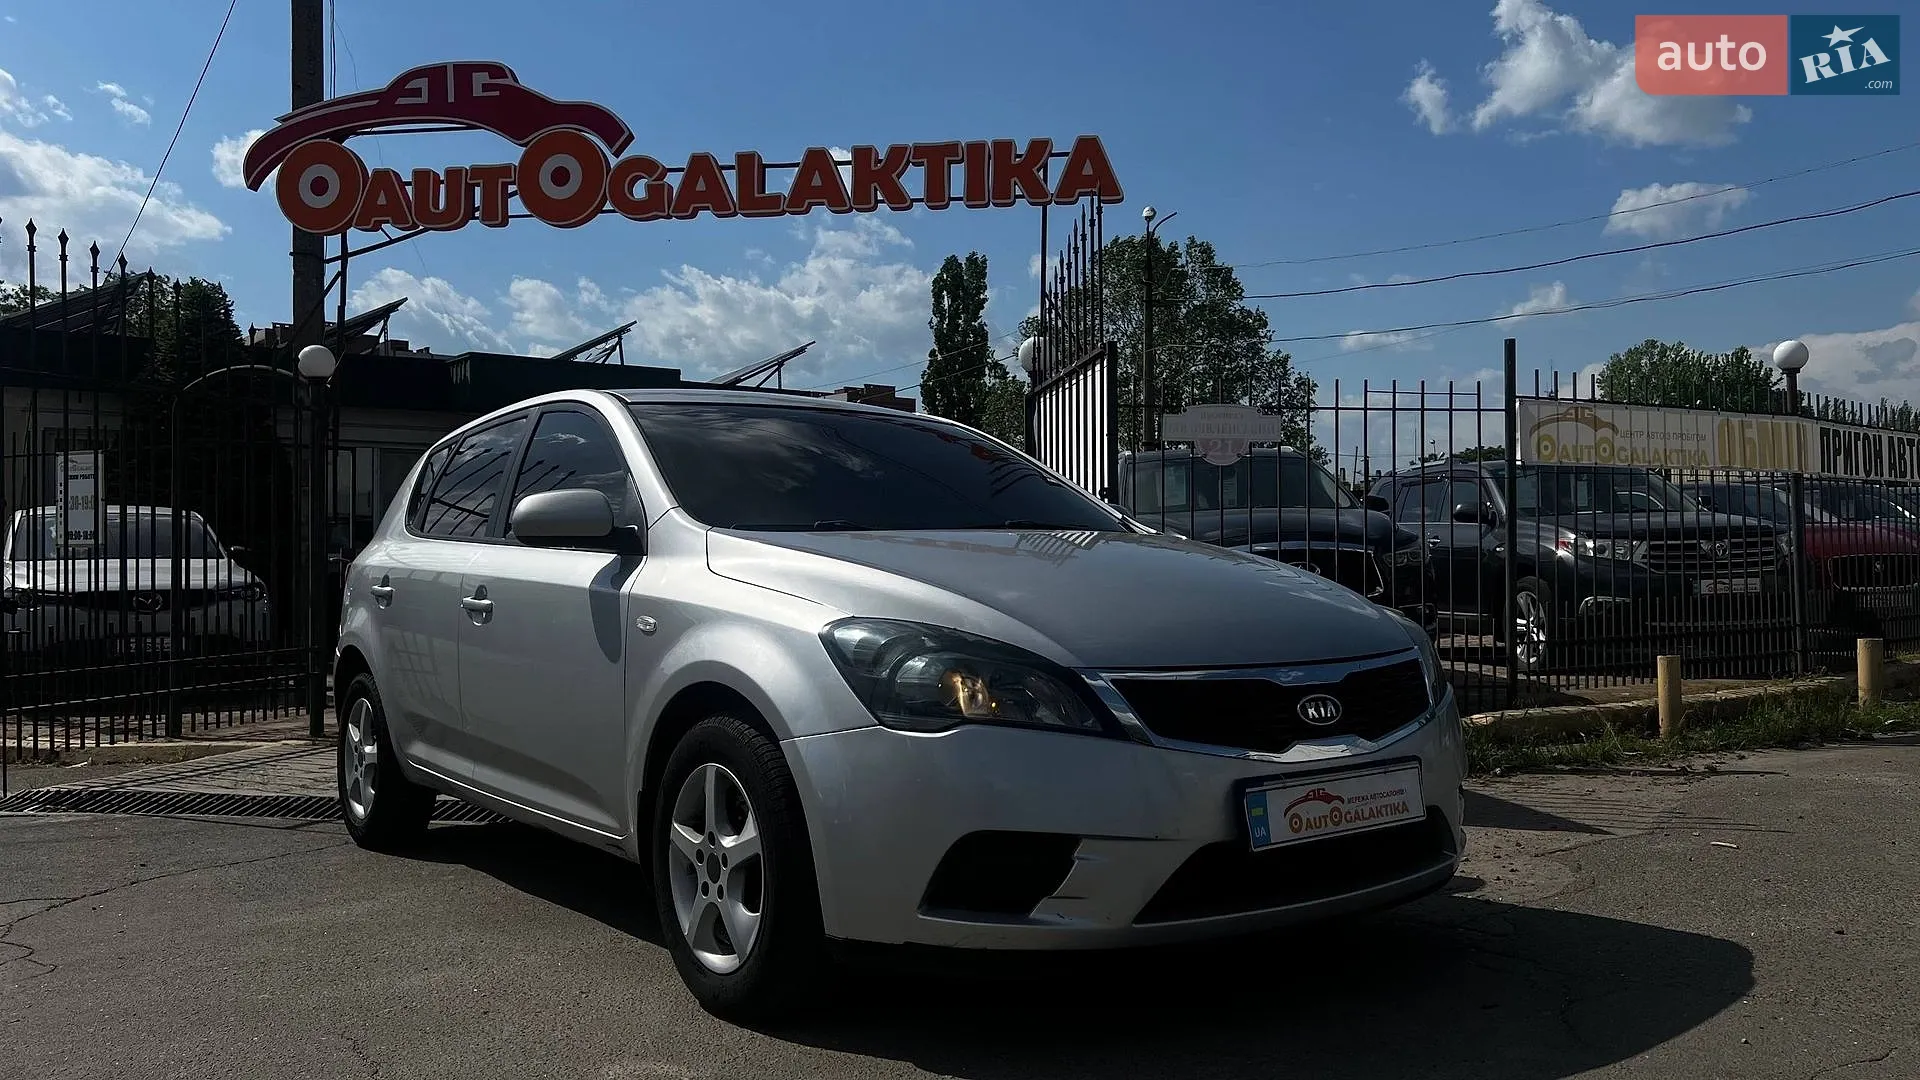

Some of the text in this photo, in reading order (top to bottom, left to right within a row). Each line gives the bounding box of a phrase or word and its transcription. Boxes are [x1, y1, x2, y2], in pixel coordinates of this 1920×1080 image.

[1620, 429, 1644, 440] ЦЕНТР
[1209, 439, 1233, 455] 21
[1819, 426, 1884, 479] ПРИГОН
[1305, 700, 1338, 719] KIA
[1254, 825, 1267, 838] UA
